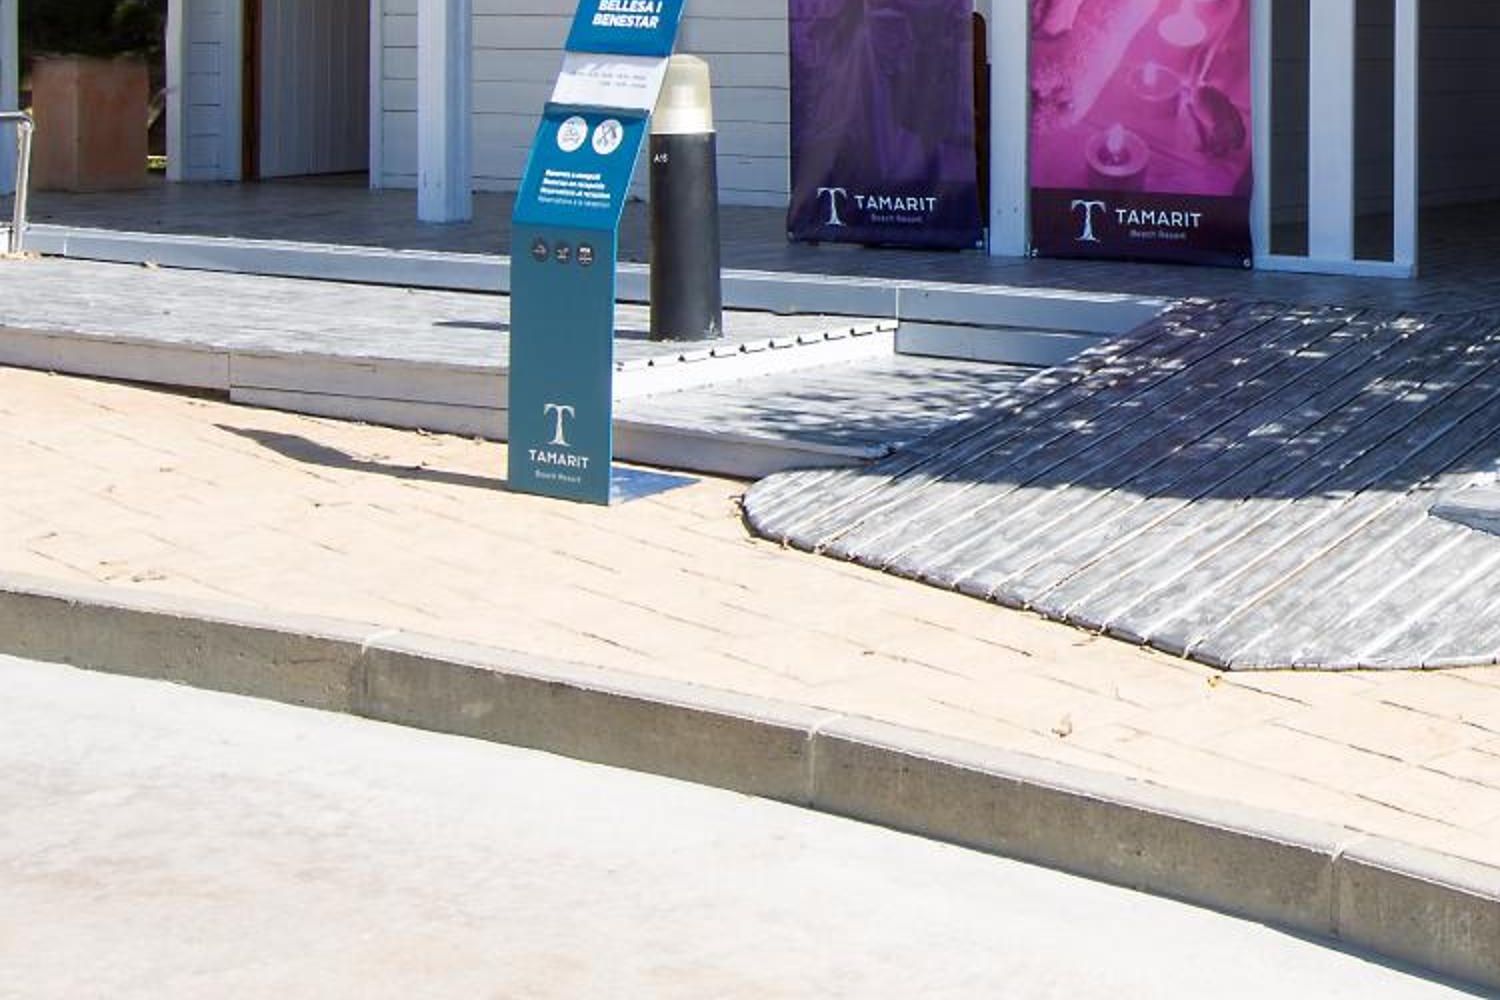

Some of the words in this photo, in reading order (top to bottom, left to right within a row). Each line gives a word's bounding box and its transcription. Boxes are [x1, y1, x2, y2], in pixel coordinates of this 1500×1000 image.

[592, 12, 660, 29] BENESTAR
[854, 195, 937, 212] TAMARIT
[1115, 208, 1202, 228] TAMARIT
[528, 449, 589, 469] TAMARIT
